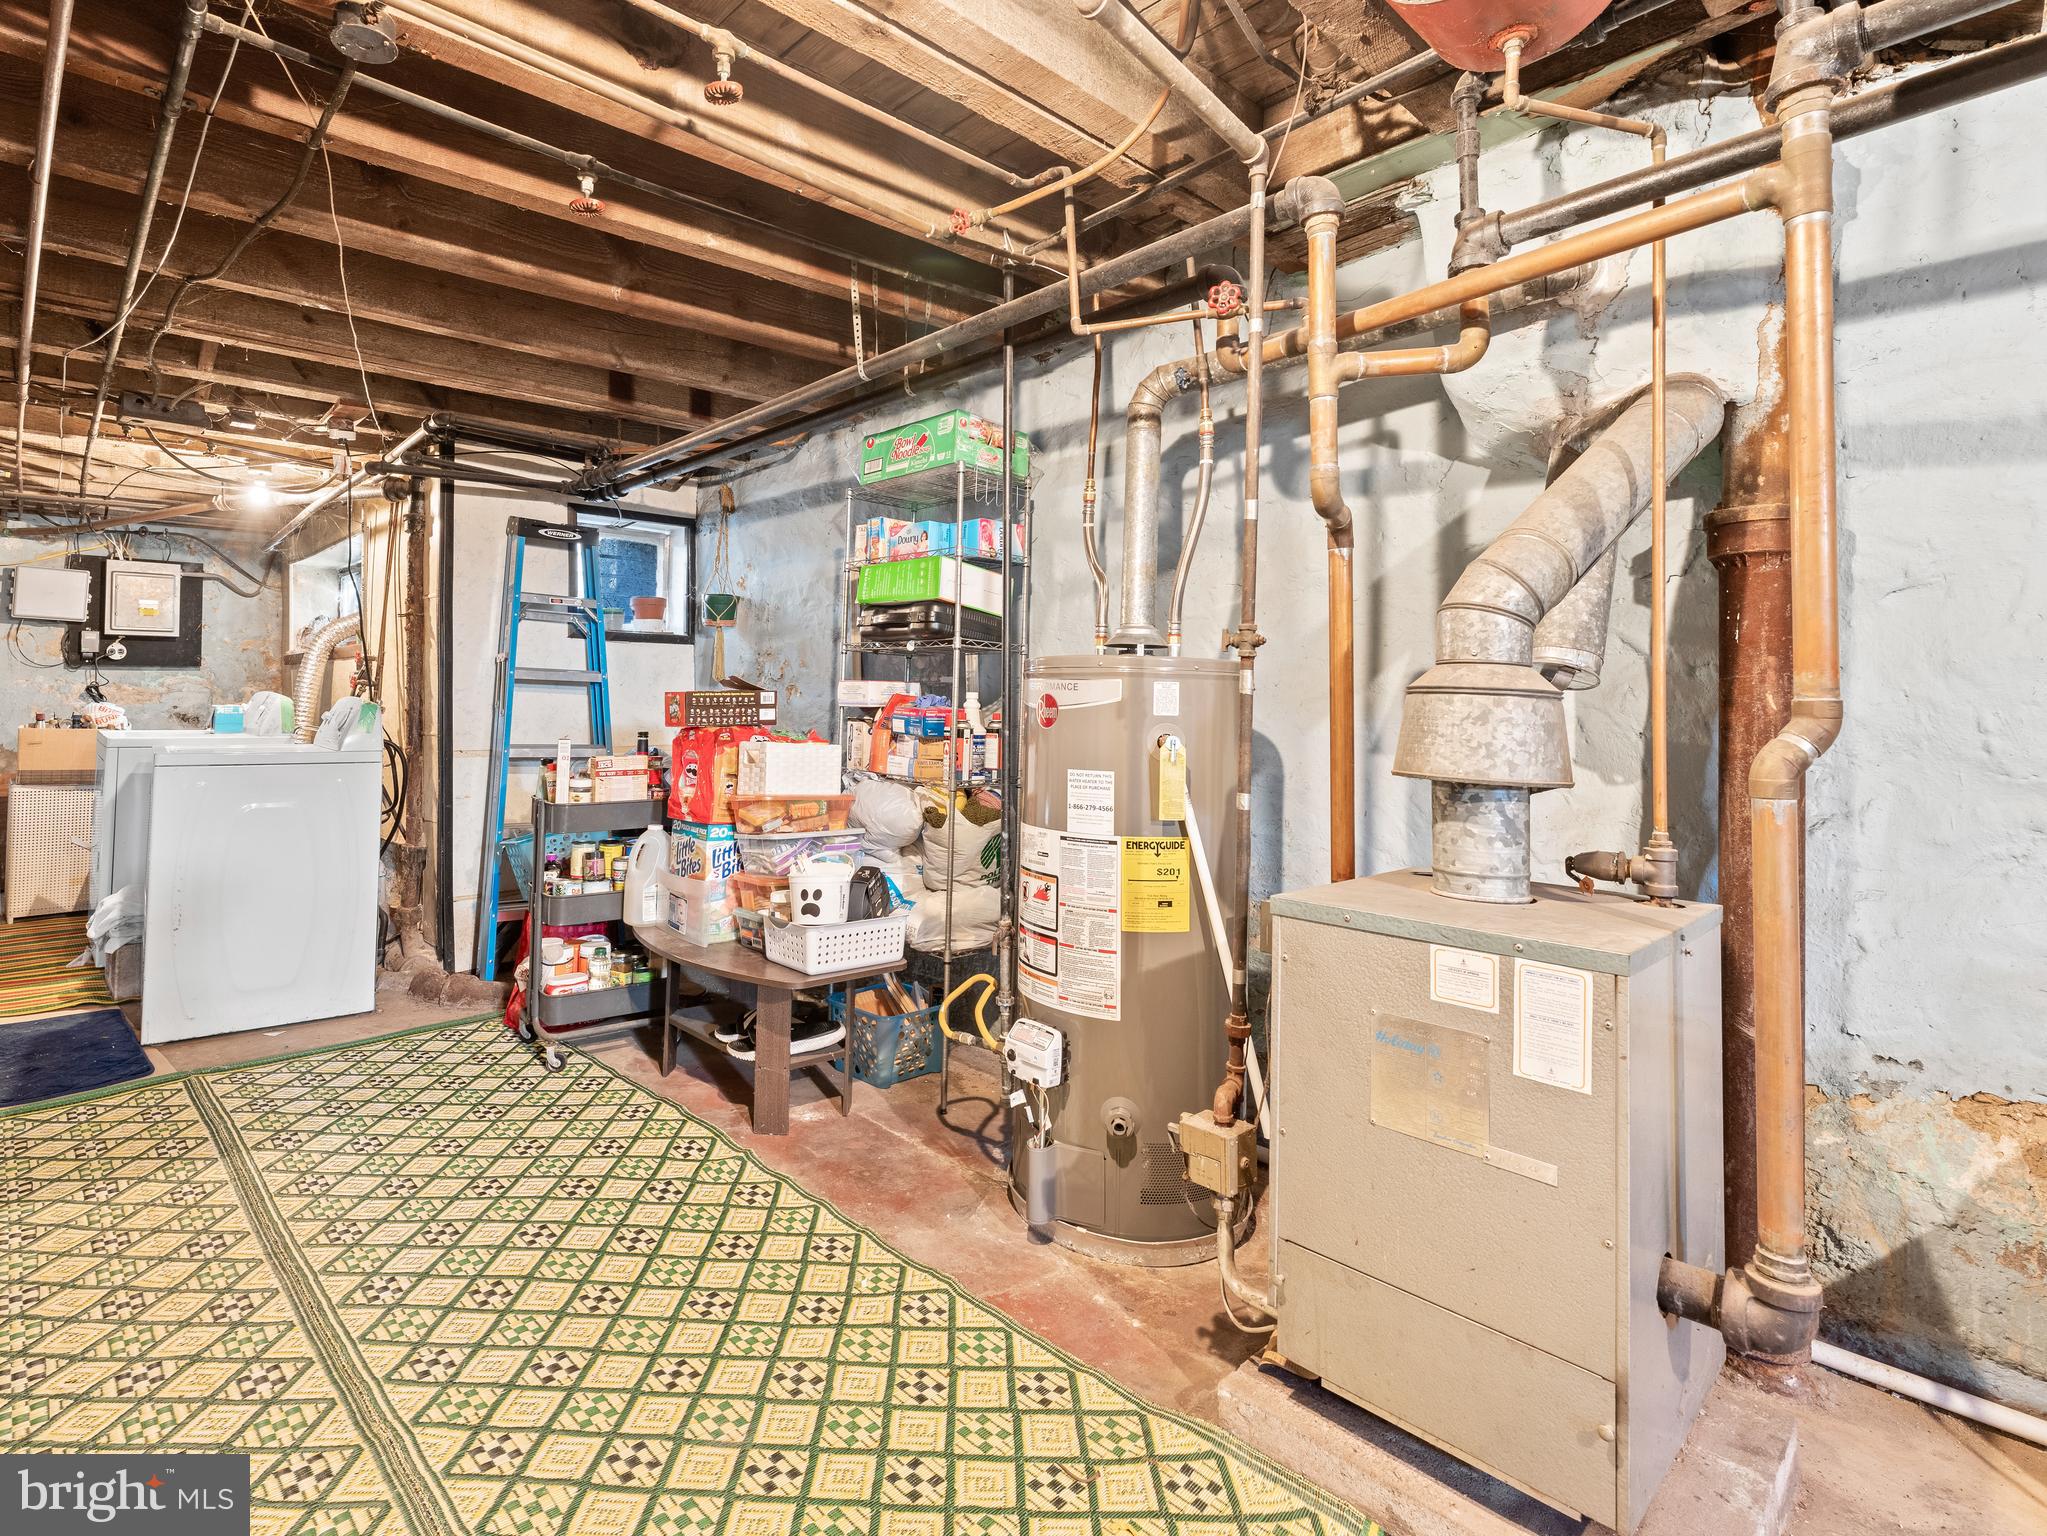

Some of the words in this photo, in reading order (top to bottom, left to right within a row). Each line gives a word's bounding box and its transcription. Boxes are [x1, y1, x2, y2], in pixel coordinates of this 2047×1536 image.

[894, 432, 917, 449] Bowl
[891, 444, 920, 461] Noodle
[547, 530, 574, 538] WERNER
[897, 535, 919, 545] Downy
[1068, 803, 1114, 813] 1-866-279-4566
[672, 820, 681, 831] 20
[709, 827, 728, 838] 20
[676, 836, 696, 865] Little
[1126, 841, 1186, 851] ENERGYGUIDE
[680, 857, 701, 878] Bites
[722, 858, 744, 879] Bit
